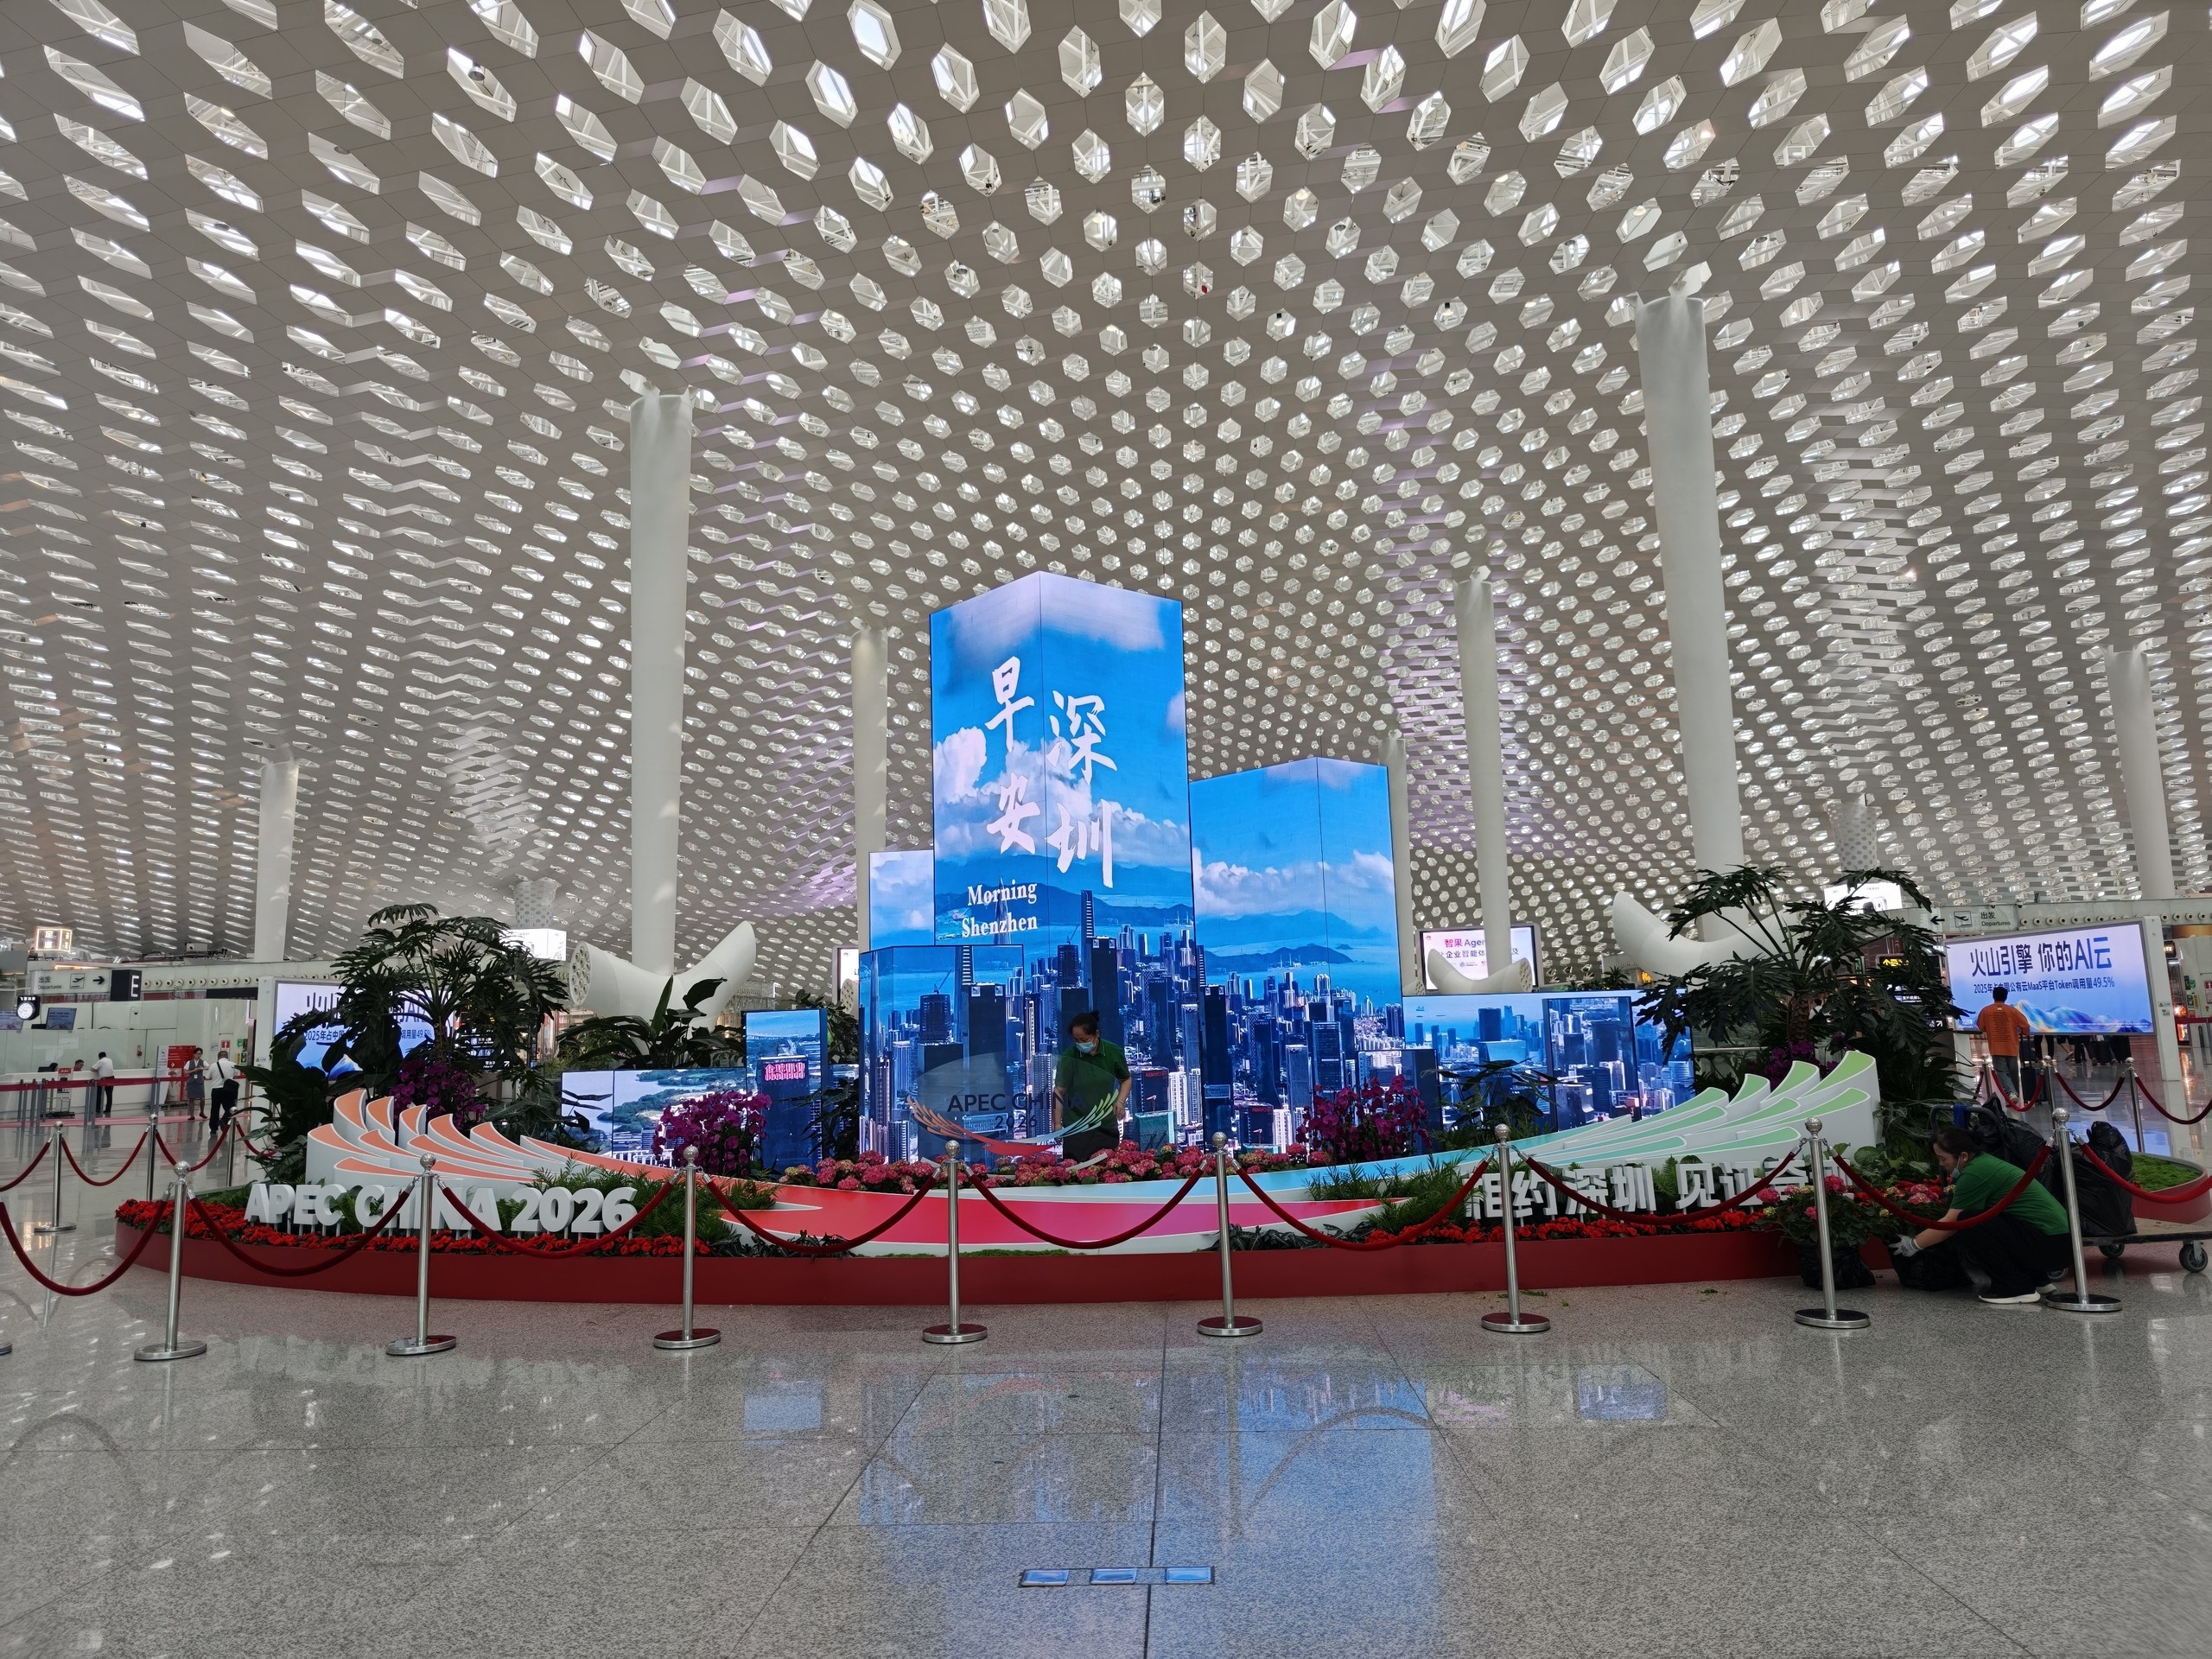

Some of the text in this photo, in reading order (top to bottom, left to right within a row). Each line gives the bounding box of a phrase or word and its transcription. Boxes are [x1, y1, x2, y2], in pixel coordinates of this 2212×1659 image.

[984, 656, 1040, 855] 早安
[1045, 690, 1118, 888] 深圳
[968, 879, 1037, 906] Morning
[962, 912, 1038, 938] Shenzhen
[1440, 950, 1485, 958] 企业智能体
[1445, 938, 1463, 948] 智果
[1970, 937, 2112, 976] 火山引擎 你的AI云
[130, 976, 139, 997] E
[947, 1090, 1086, 1112] APEC CHINA
[995, 1115, 1037, 1128] 2026
[1462, 1164, 1656, 1220] 相约深圳
[244, 1183, 638, 1233] APEC CHINA 2026
